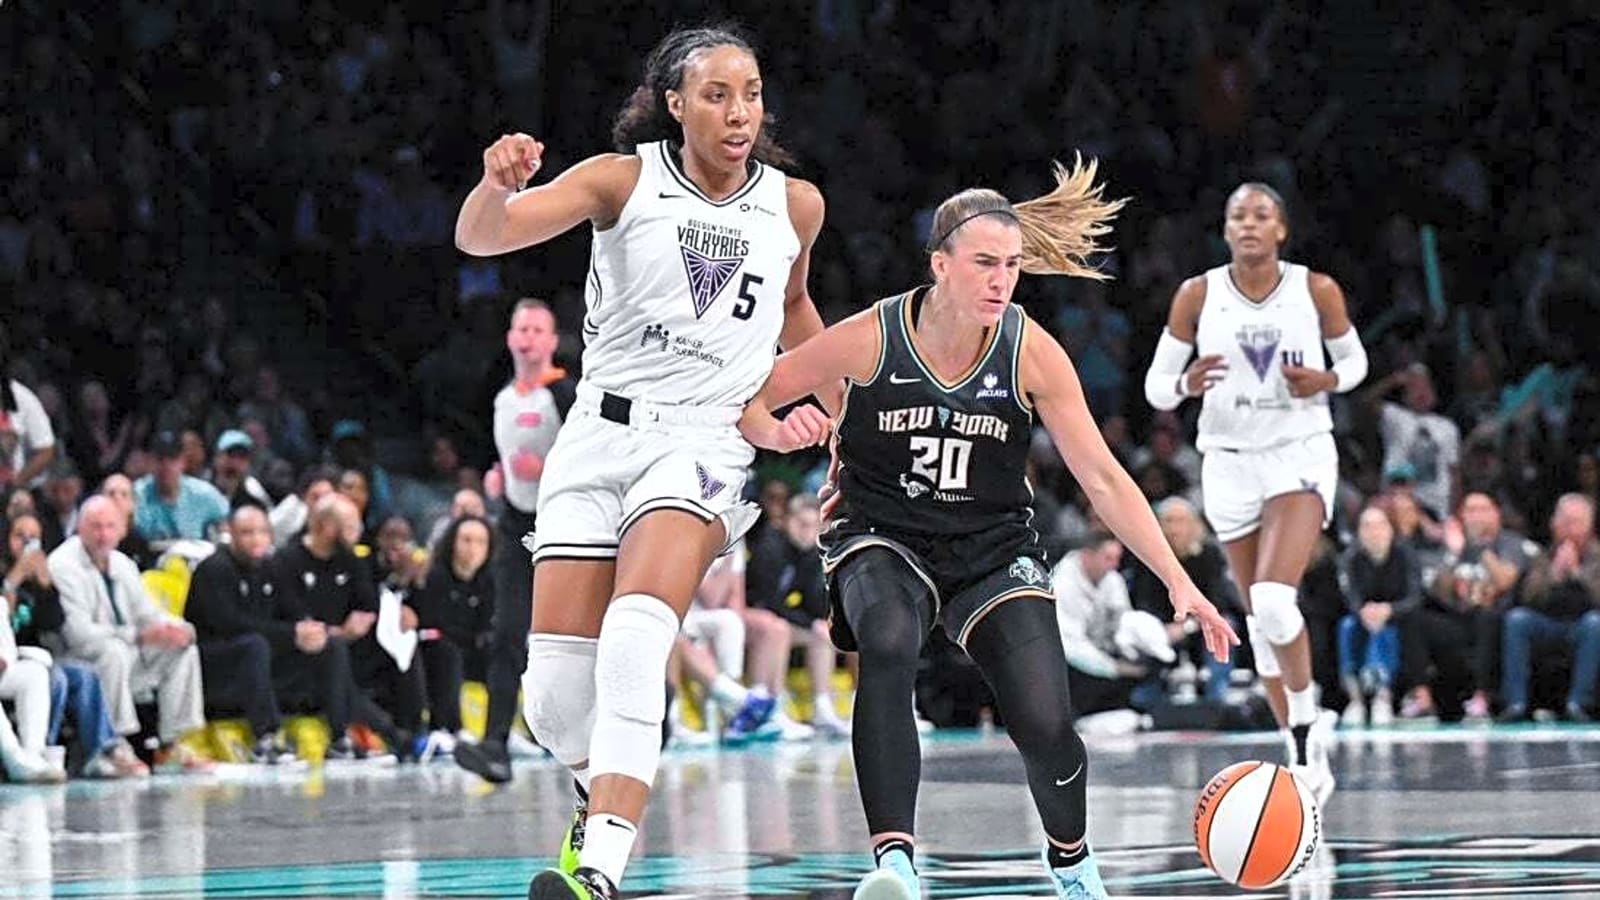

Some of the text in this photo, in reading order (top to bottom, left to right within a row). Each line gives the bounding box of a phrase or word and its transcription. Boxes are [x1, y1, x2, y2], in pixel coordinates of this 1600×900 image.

[677, 225, 750, 258] VALKYRIES
[731, 272, 764, 321] 5
[675, 335, 703, 350] KAER
[878, 406, 1009, 442] NEW YORK
[909, 436, 973, 489] 20
